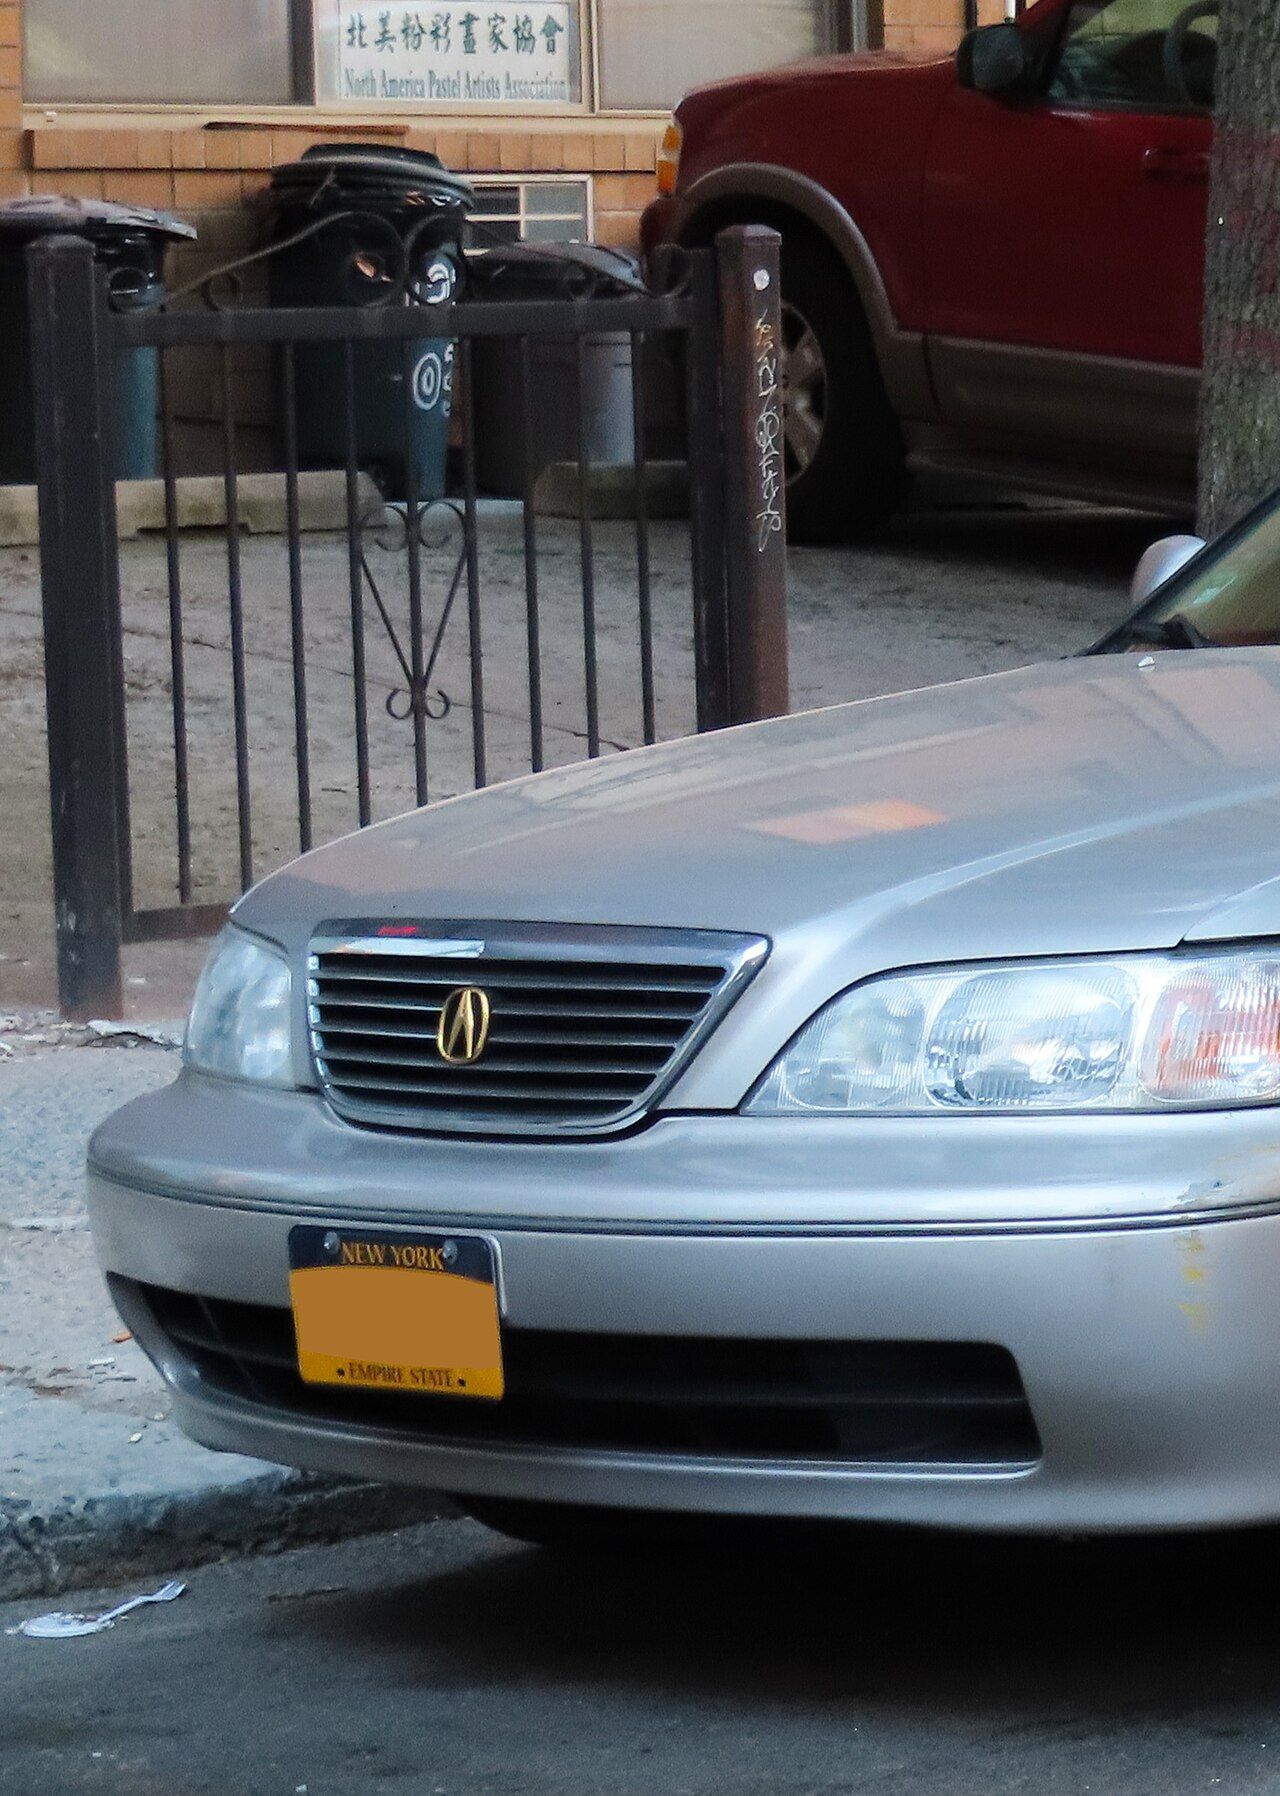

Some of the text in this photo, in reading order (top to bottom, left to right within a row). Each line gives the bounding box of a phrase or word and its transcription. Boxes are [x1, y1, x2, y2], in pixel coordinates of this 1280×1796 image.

[347, 11, 564, 54] 北美粉彩畫家協會
[344, 67, 568, 99] North America Pastel Artists Association
[342, 1241, 445, 1271] NEW YORK
[348, 1362, 452, 1387] EMPIRE STATE
